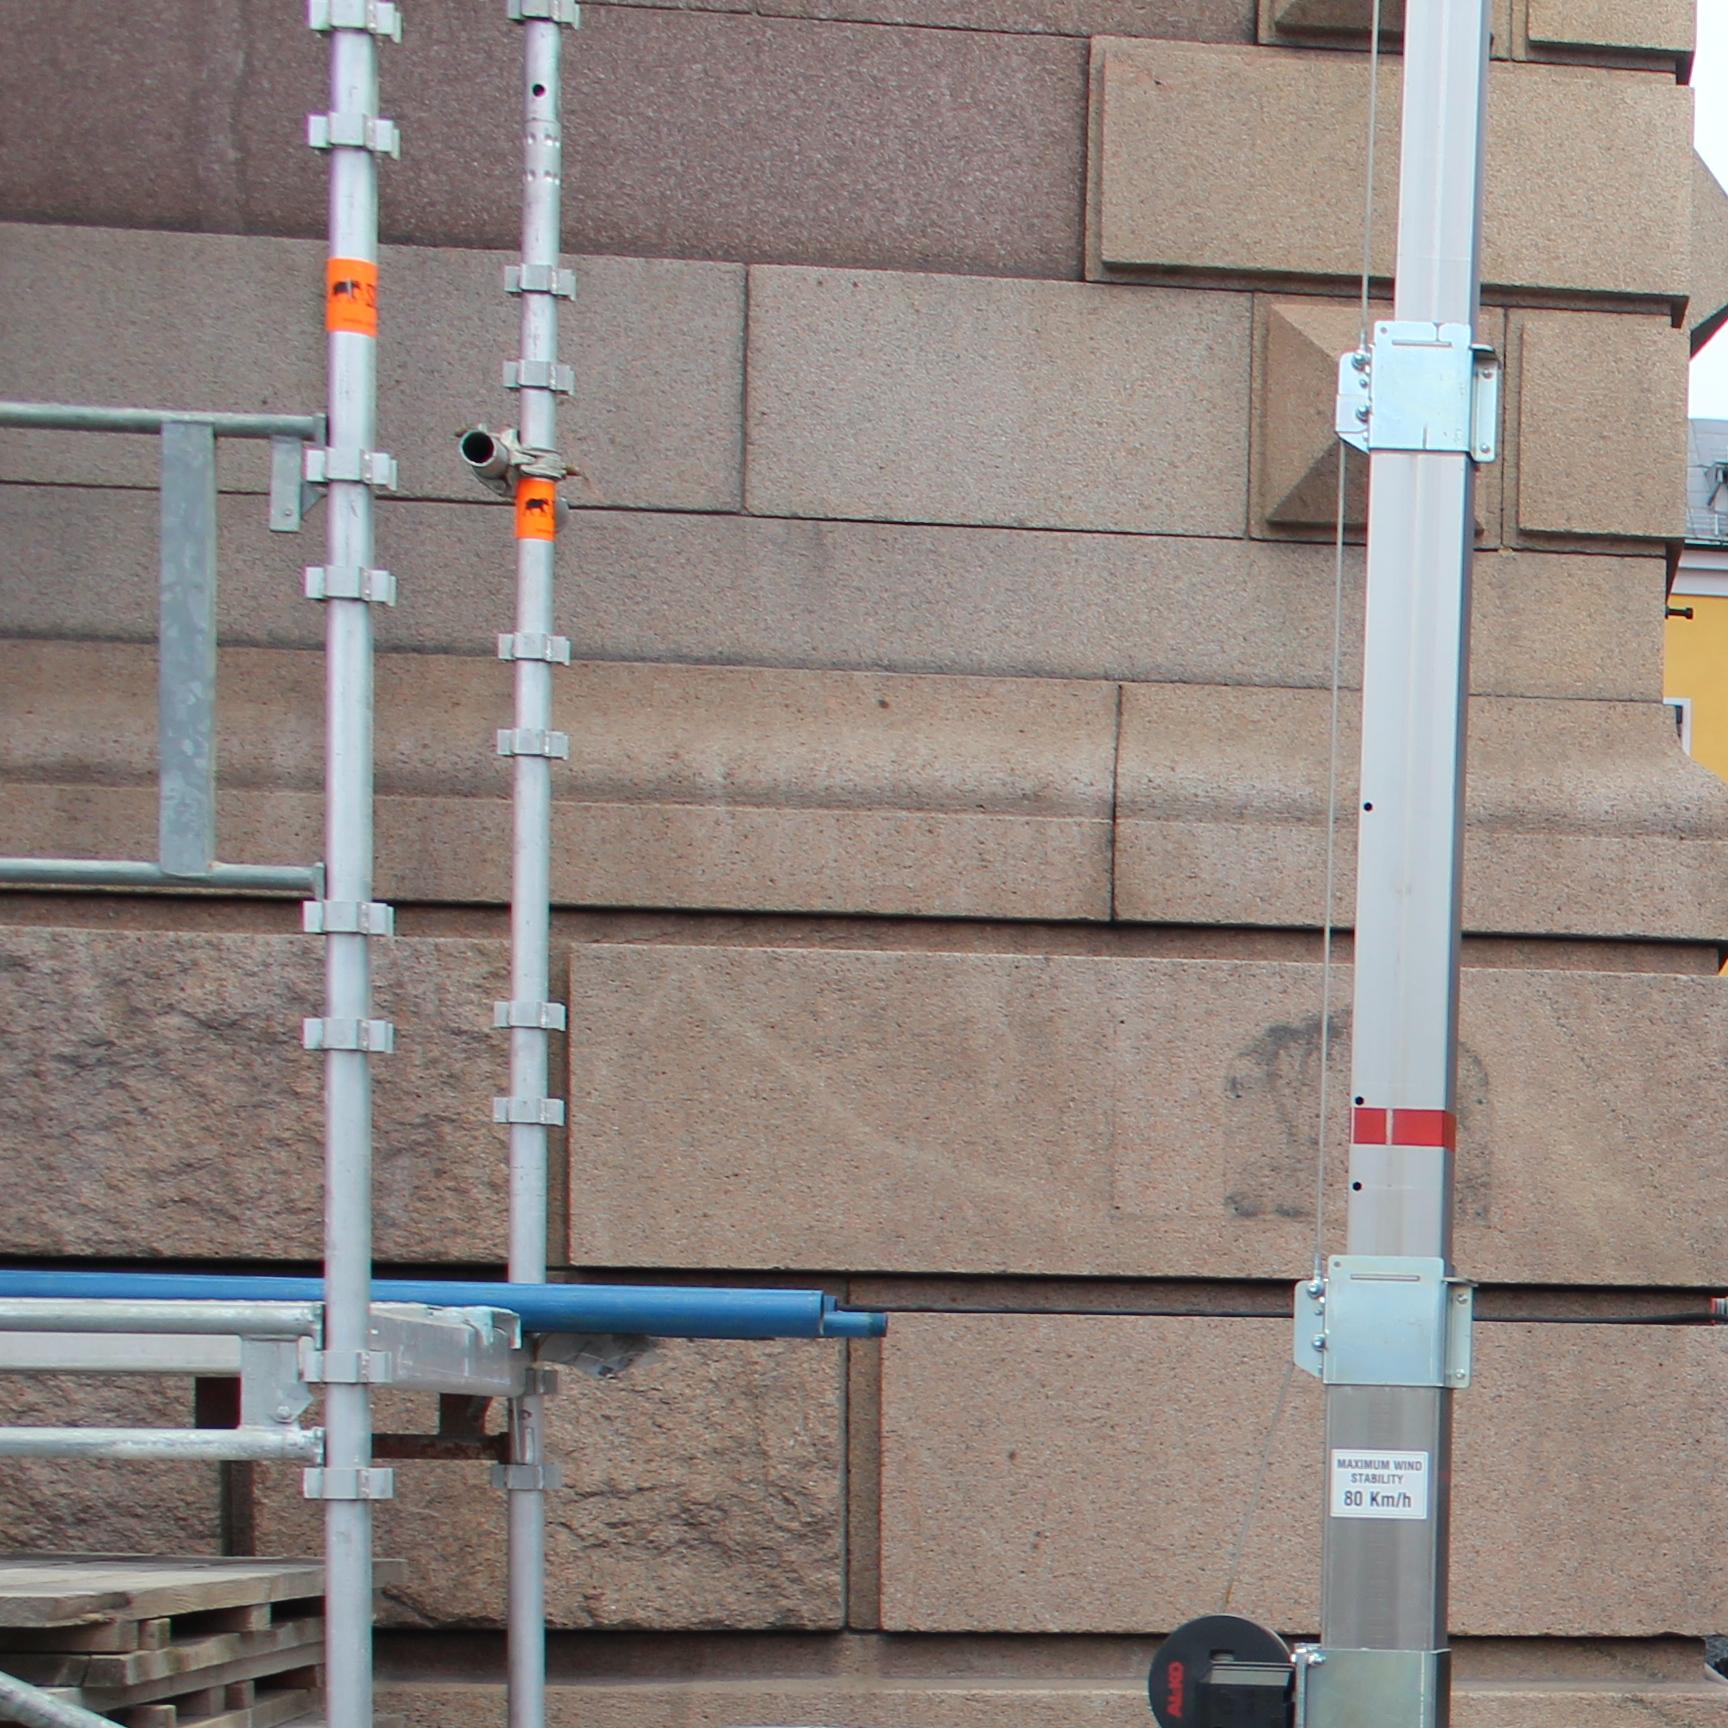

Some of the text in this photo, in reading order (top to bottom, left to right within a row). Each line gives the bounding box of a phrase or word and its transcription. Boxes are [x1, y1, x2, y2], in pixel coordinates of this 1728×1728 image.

[1337, 1458, 1422, 1471] MAXIMUM WIND
[1350, 1473, 1404, 1485] STABILITY
[1344, 1490, 1412, 1508] 80 Km/h
